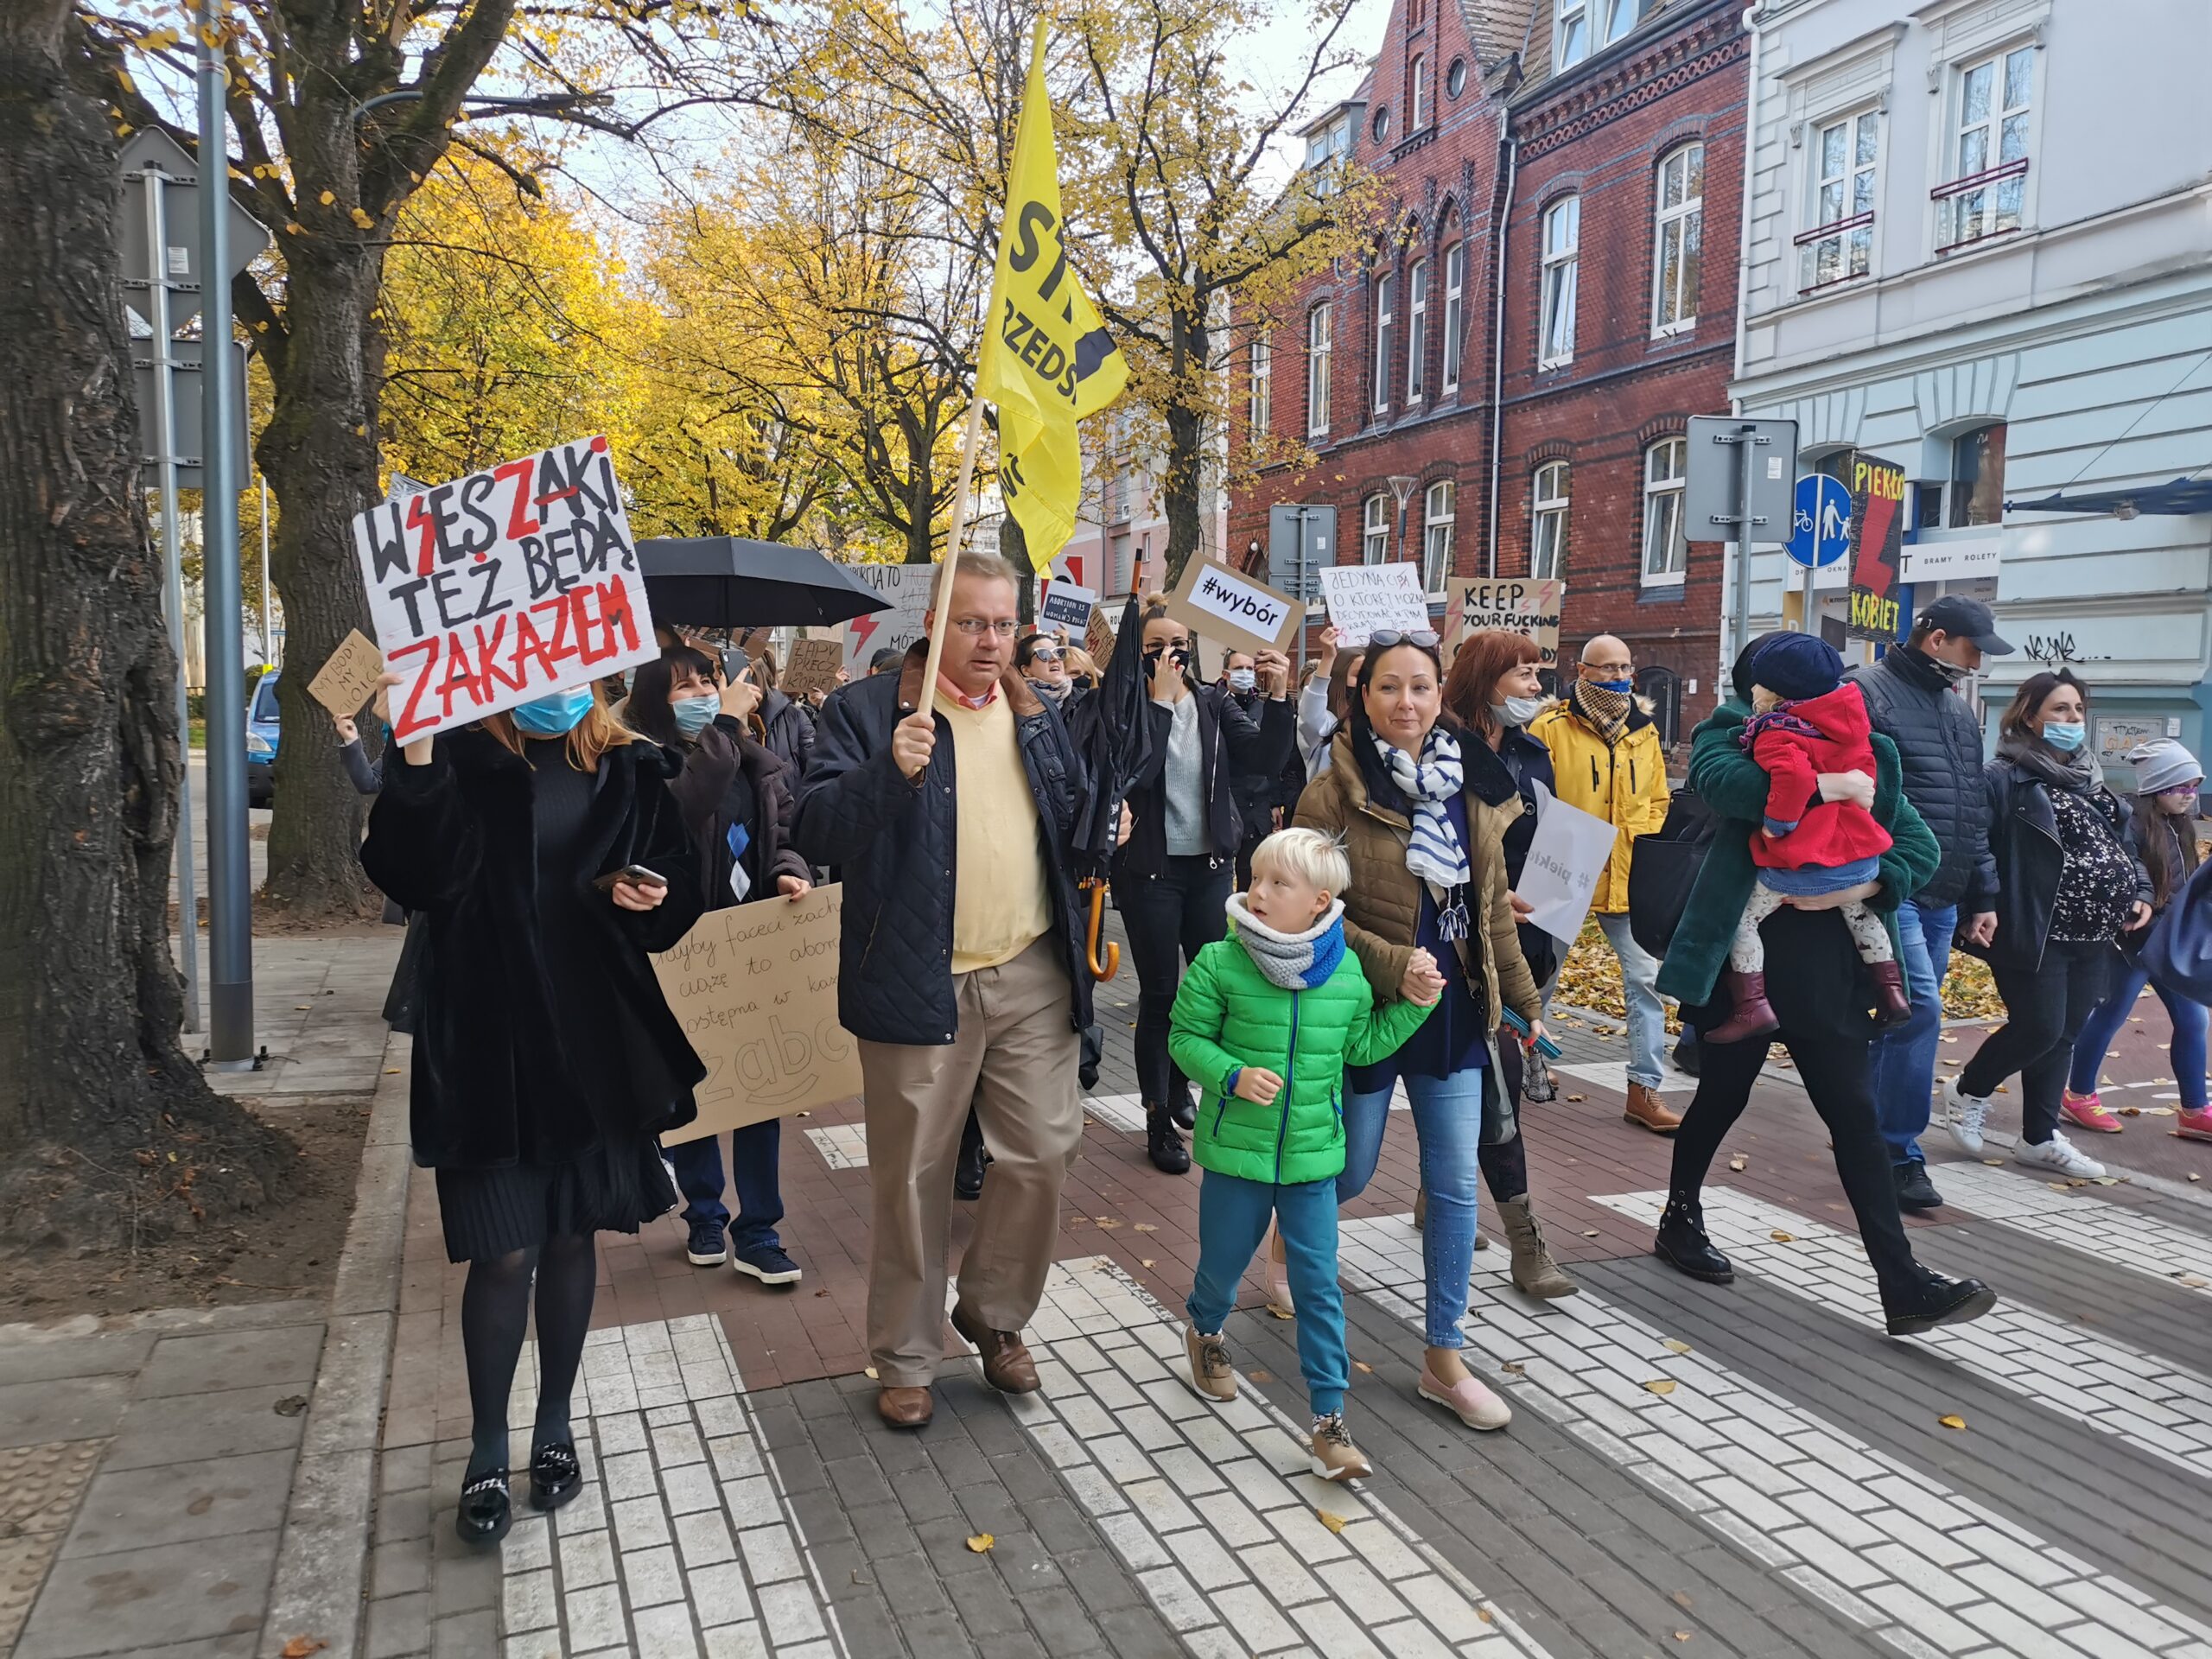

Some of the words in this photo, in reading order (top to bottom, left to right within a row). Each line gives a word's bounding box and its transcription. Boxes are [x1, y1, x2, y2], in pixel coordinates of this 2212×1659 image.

[1854, 461, 1905, 501] PIEKŁO
[1924, 556, 1953, 565] BRAMY
[1964, 552, 1997, 561] ROLETY
[886, 565, 900, 588] TO
[389, 552, 512, 637] TEŻ
[1049, 596, 1077, 609] ABORTION
[1078, 603, 1086, 612] IS
[1203, 576, 1278, 626] #wybór
[1465, 583, 1524, 611] KEEP
[1463, 613, 1501, 626] YOUR
[1504, 613, 1560, 627] FUCKING
[1852, 591, 1899, 633] KOBIET
[315, 674, 334, 697] MY
[329, 640, 358, 676] BODY
[387, 574, 640, 739] ZAKAZEM
[793, 658, 836, 672] PRECZ
[339, 668, 355, 691] MY
[725, 914, 785, 957] faceci
[746, 957, 772, 975] to
[773, 990, 792, 1005] w
